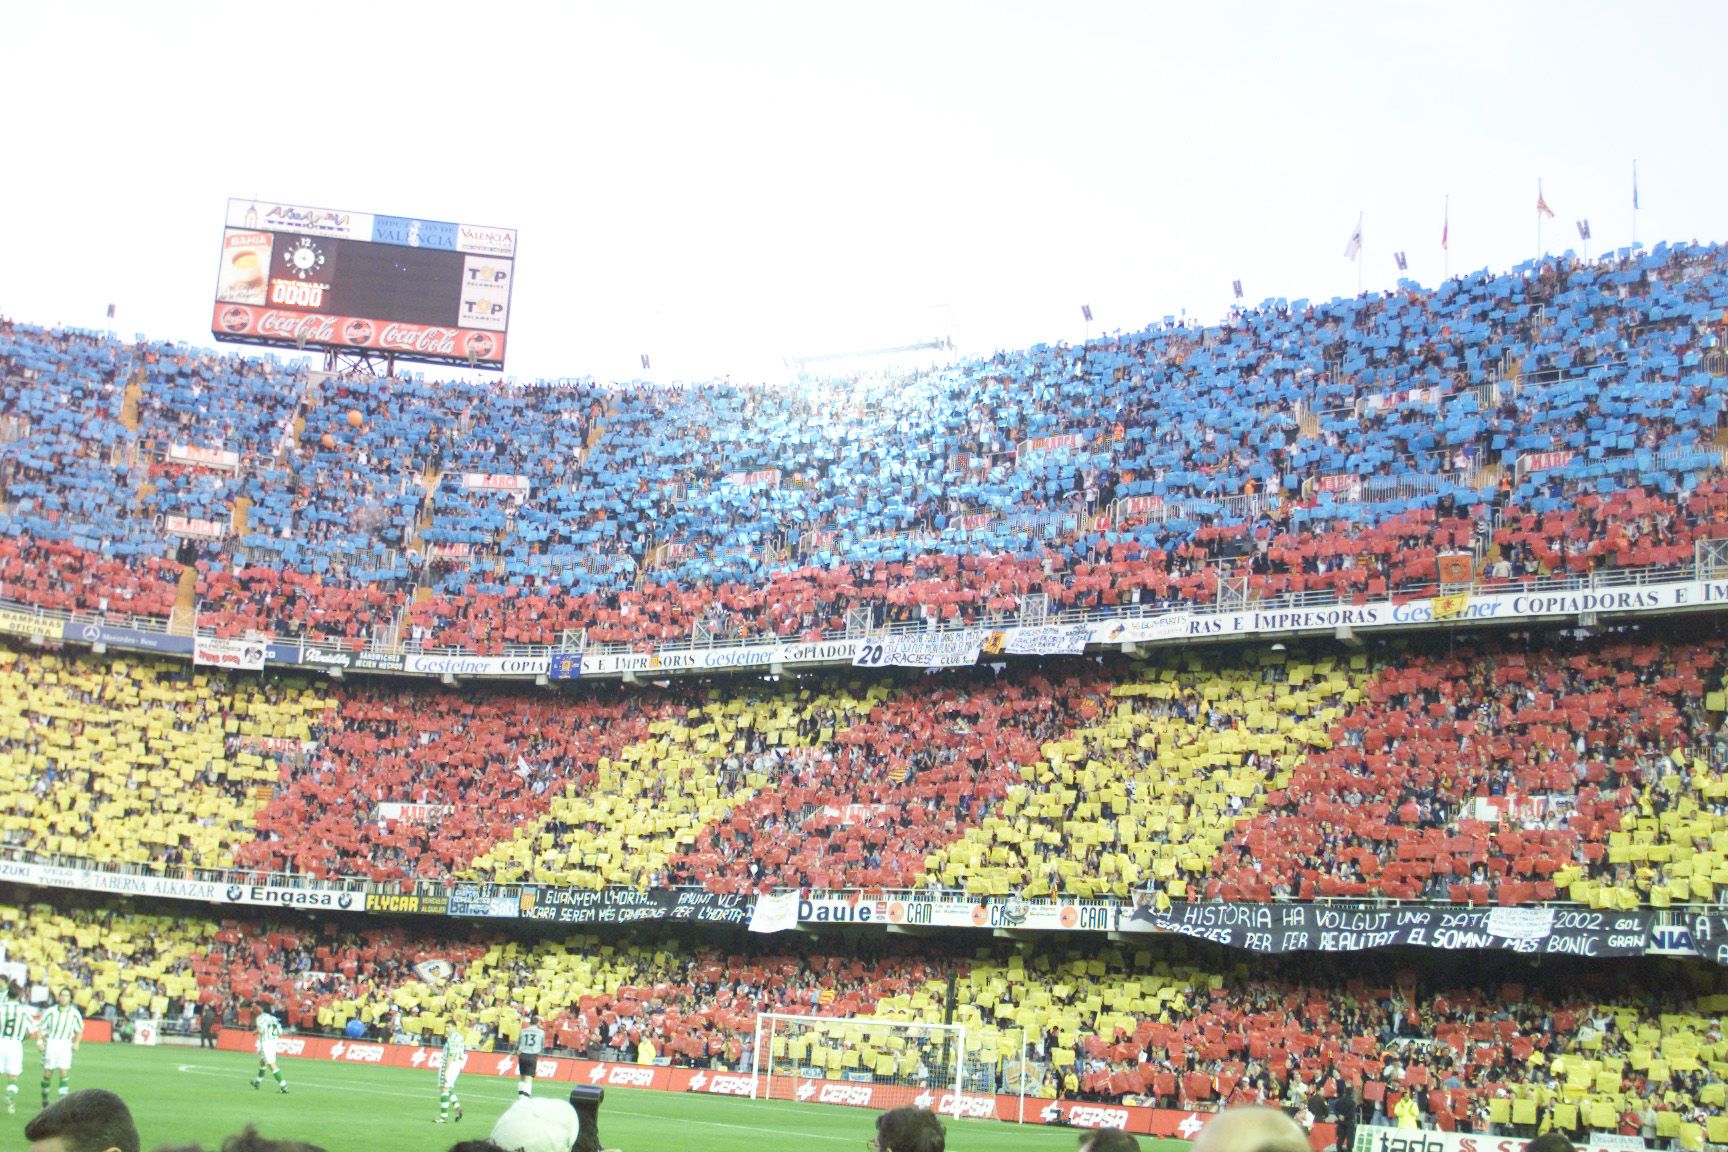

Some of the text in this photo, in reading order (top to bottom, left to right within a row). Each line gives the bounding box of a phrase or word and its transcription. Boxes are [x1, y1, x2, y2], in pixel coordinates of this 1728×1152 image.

[301, 238, 311, 247] 12
[257, 310, 338, 340] Coca-Cola
[380, 323, 459, 354] Coca-Cola
[1513, 590, 1658, 613] COPIADORAS
[1675, 587, 1688, 604] E
[2, 612, 62, 628] MAMPARAS
[9, 623, 51, 636] OFICINA
[1233, 616, 1245, 631] E
[1254, 608, 1378, 629] IMPRESORAS
[415, 656, 492, 674] Gestetner
[615, 655, 696, 671] IMPRSORAS
[704, 650, 775, 667] Gestetner
[857, 645, 883, 665] 20
[0, 864, 30, 877] ZUKI
[93, 875, 215, 898] TABERNA ALKAZAR
[251, 887, 332, 908] Engasa
[366, 895, 419, 912] FLYCAR
[559, 907, 595, 922] SEREM
[670, 906, 695, 919] PER
[906, 903, 933, 924] CAM
[1080, 907, 1108, 929] CAM
[1283, 907, 1305, 927] HA
[1315, 911, 1391, 931] VOLGUT
[1397, 911, 1430, 926] UNA
[1244, 931, 1271, 952] PER
[1406, 928, 1428, 946] EL
[1607, 933, 1645, 948] GRAN
[524, 1033, 536, 1047] 13
[345, 1043, 385, 1063] CEPSA
[609, 1066, 655, 1086] CEPSA
[709, 1074, 758, 1095] CEPSA
[819, 1084, 873, 1106] CEPSA
[1068, 1105, 1129, 1130] CEPSA
